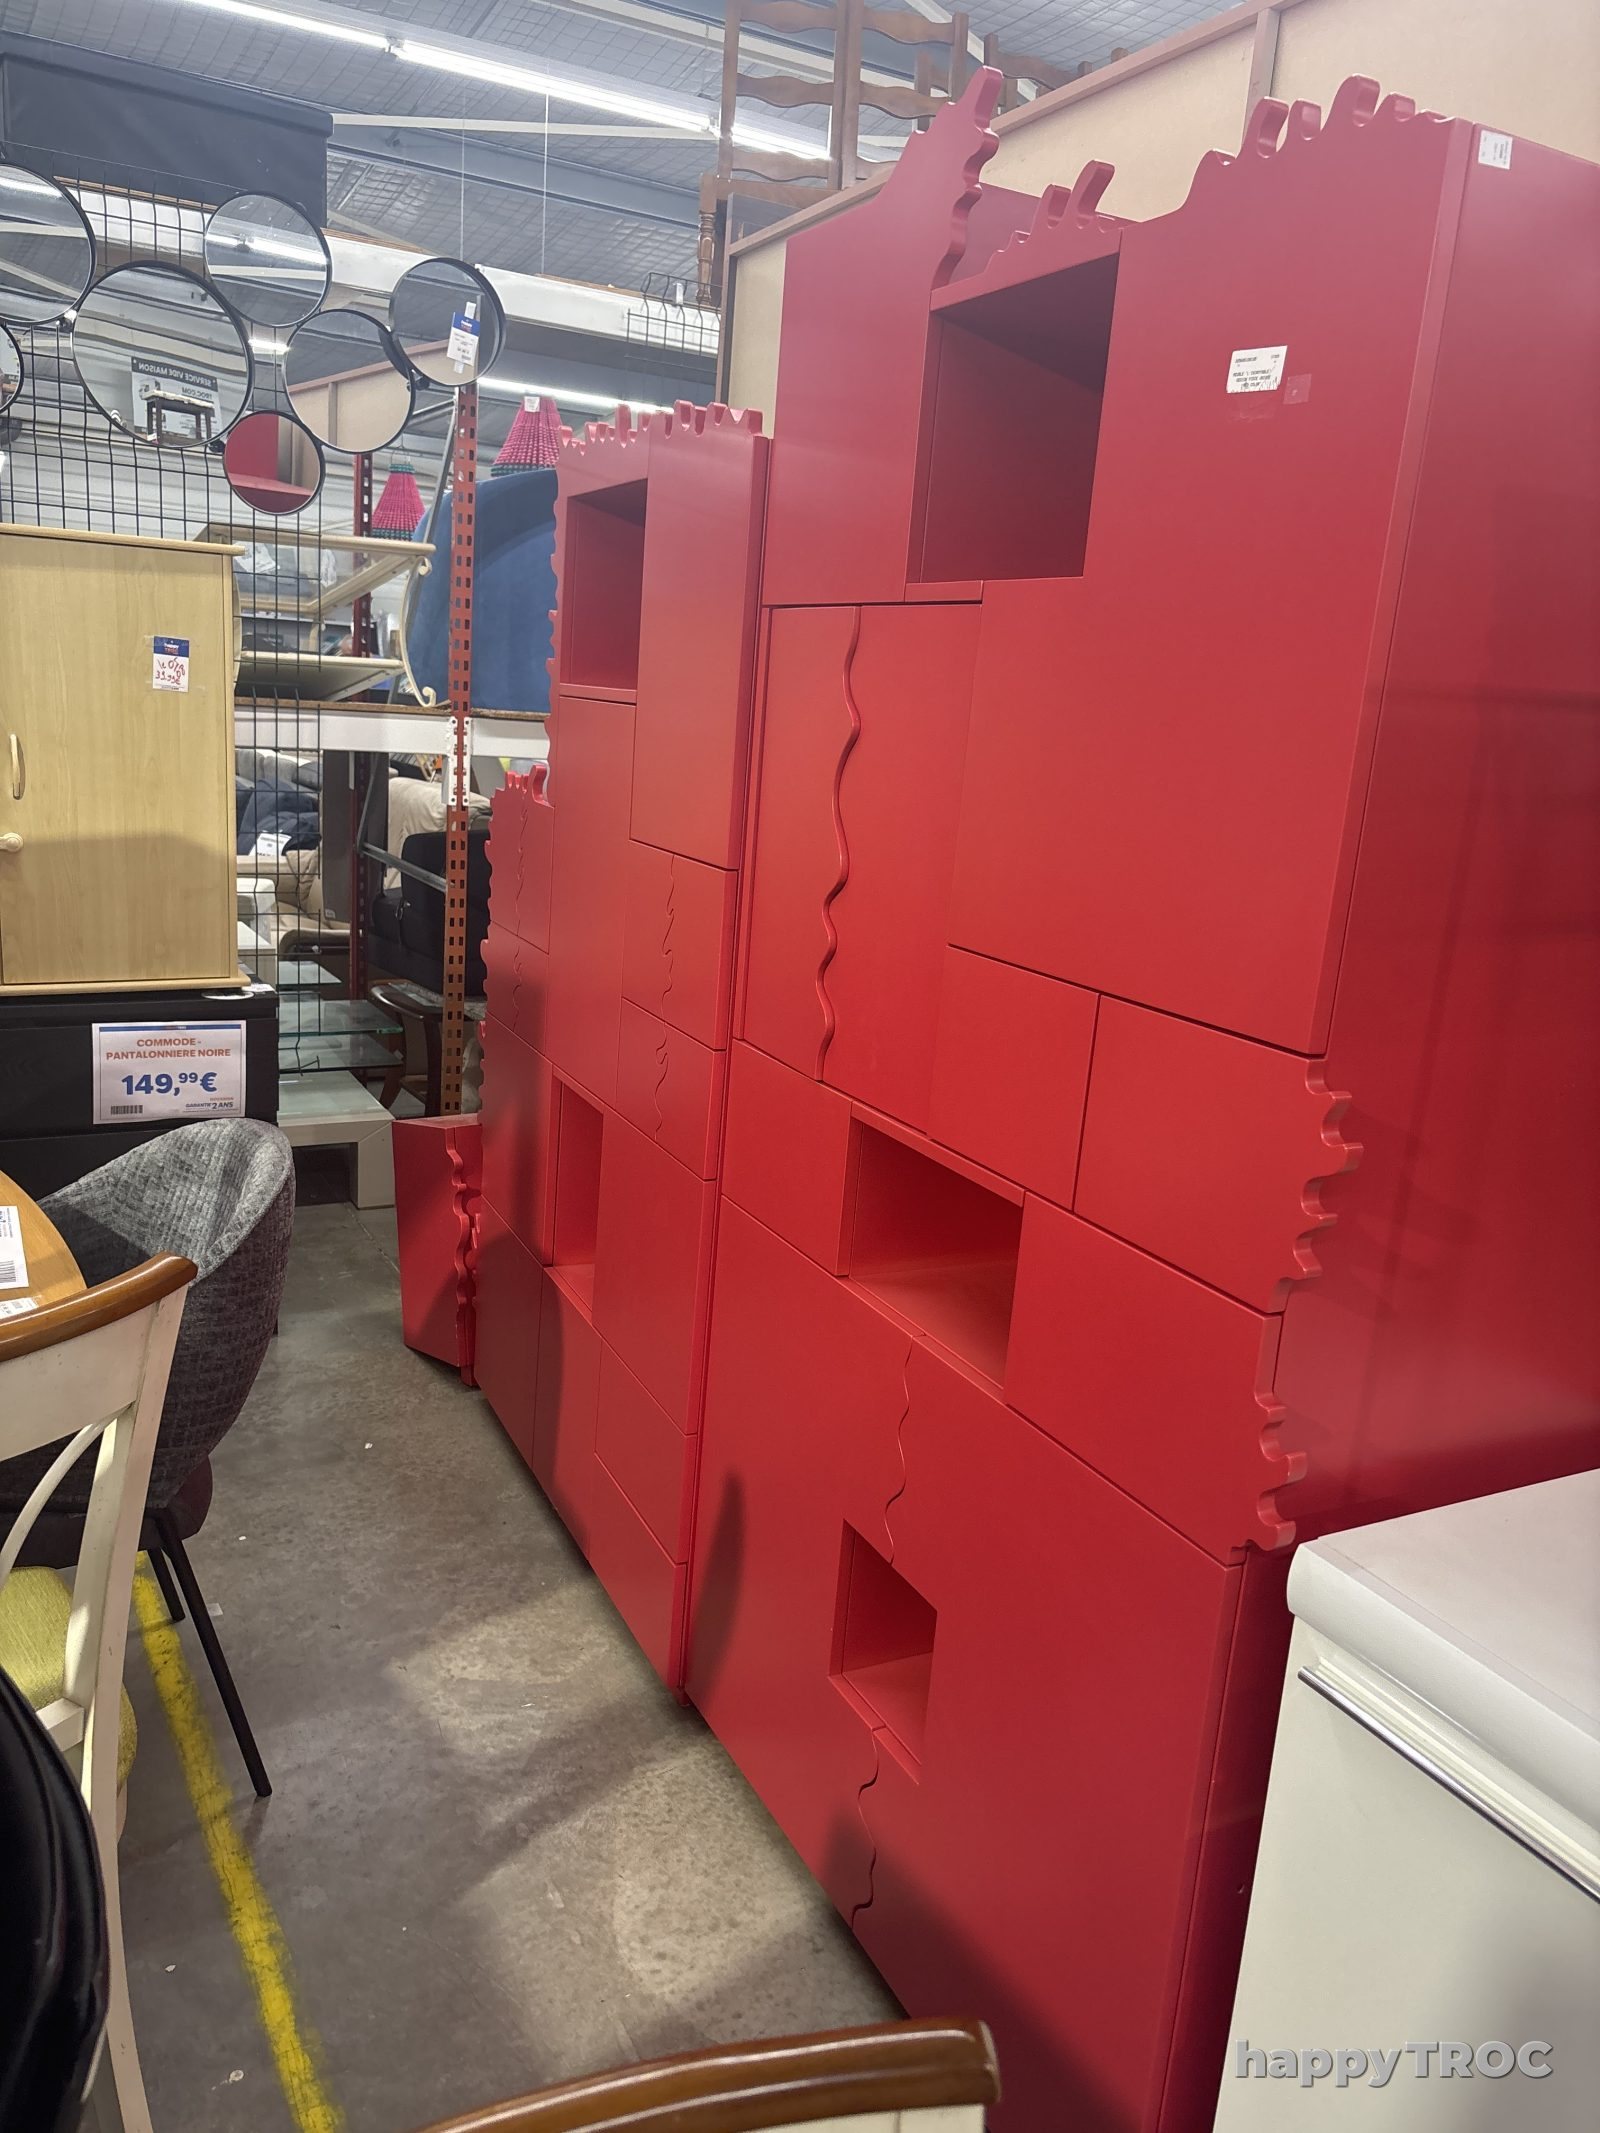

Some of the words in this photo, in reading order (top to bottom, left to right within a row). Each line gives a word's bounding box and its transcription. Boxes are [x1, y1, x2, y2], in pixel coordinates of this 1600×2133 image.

[136, 1038, 196, 1047] COMMODE
[106, 1049, 196, 1060] PANTALONNIERE
[198, 1048, 231, 1057] NOIRE
[212, 1102, 218, 1110] 2
